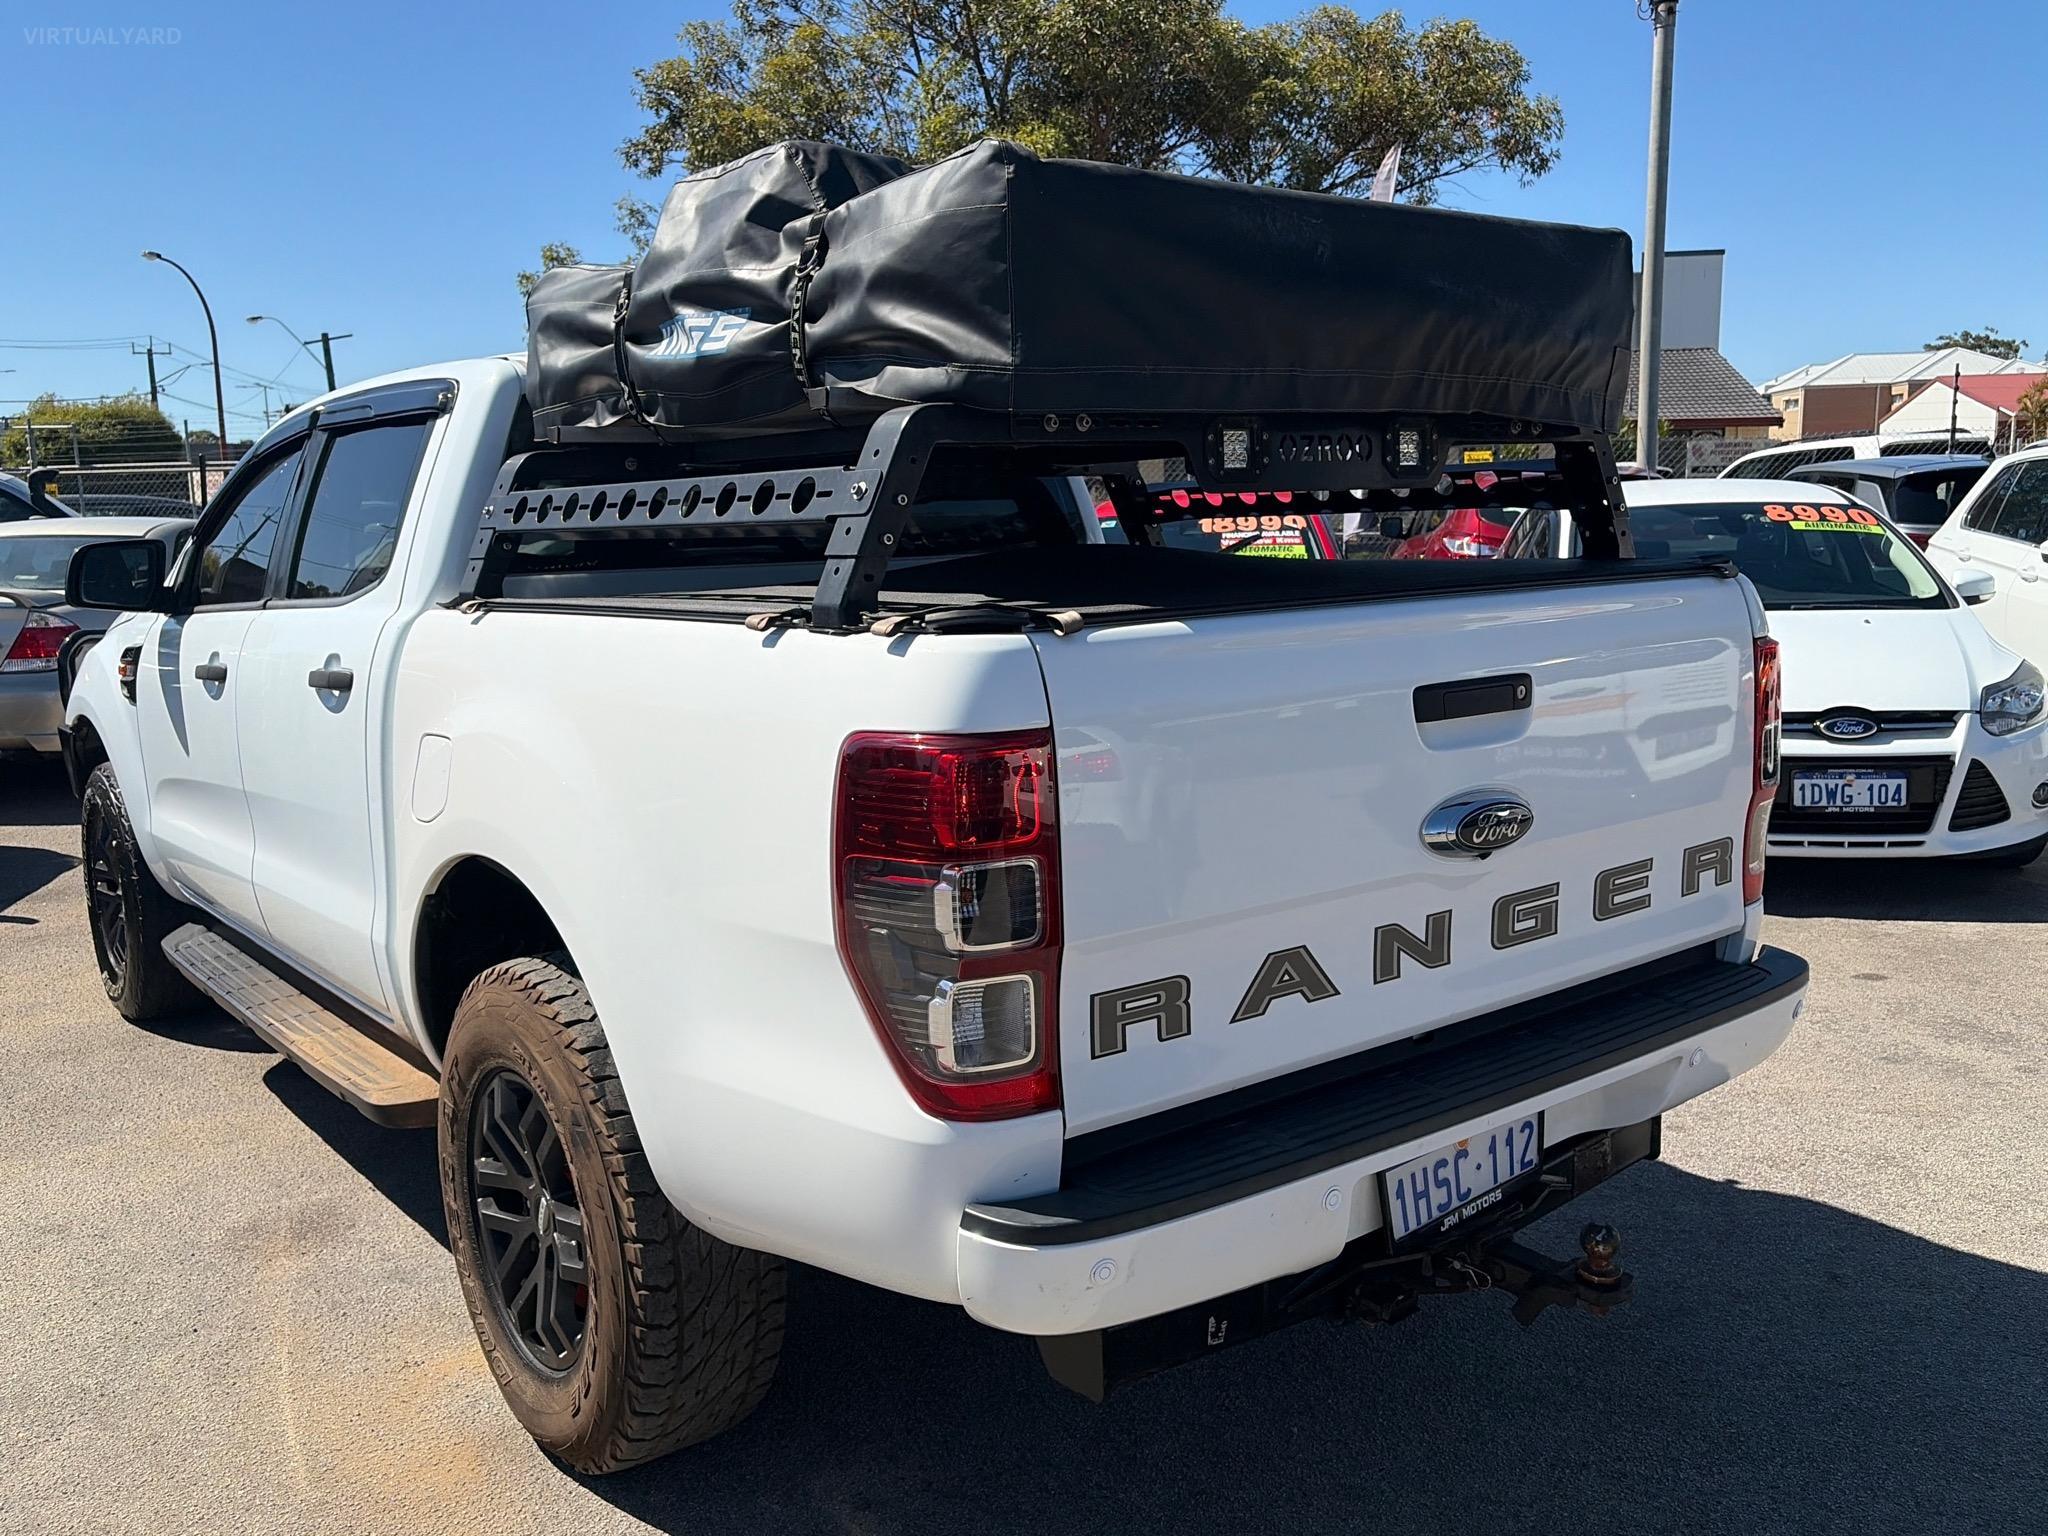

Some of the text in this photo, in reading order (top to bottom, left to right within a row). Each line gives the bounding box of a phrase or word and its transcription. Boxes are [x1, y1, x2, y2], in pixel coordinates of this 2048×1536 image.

[1279, 433, 1374, 462] OZROO
[1763, 504, 1878, 526] 8990
[1804, 522, 1873, 532] AUTOMATIC
[1239, 545, 1295, 553] UTOMATIC
[1834, 720, 1866, 733] Ford
[1472, 811, 1528, 844] Ford
[1089, 836, 1735, 1060] RANGER
[1462, 1188, 1502, 1219] MOTORS
